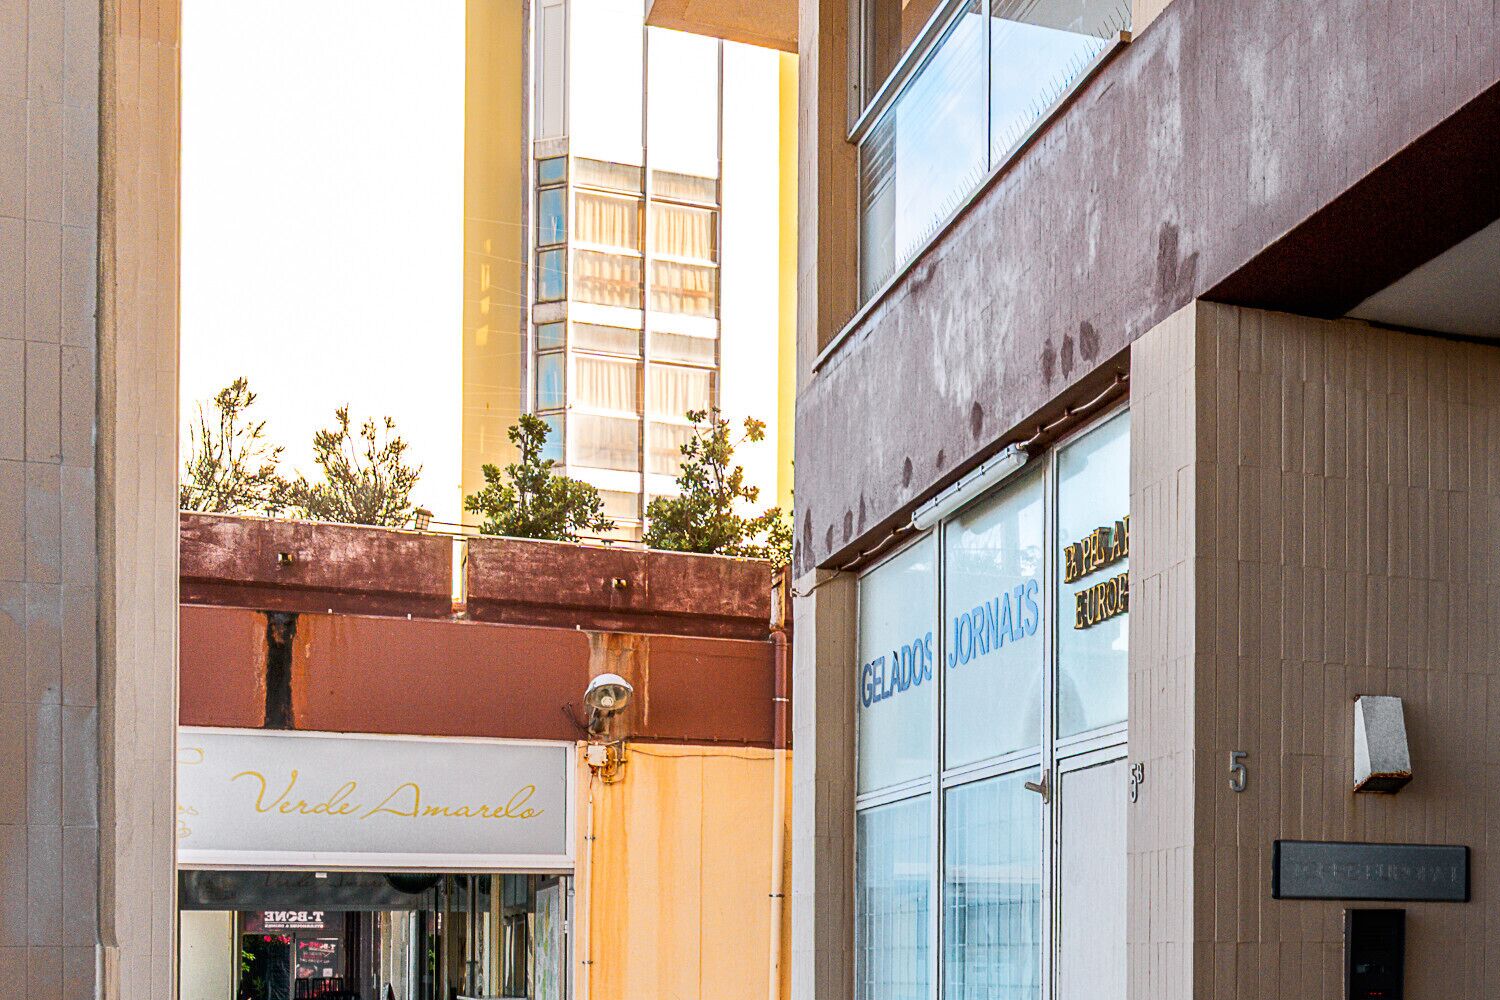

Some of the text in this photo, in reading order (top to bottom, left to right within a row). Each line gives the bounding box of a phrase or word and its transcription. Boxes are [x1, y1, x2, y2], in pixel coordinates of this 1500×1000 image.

[1074, 570, 1129, 629] EUROP
[862, 578, 1039, 708] GELADOS JORNAIS
[231, 768, 545, 820] Verde Amarelo
[1229, 750, 1247, 792] 5
